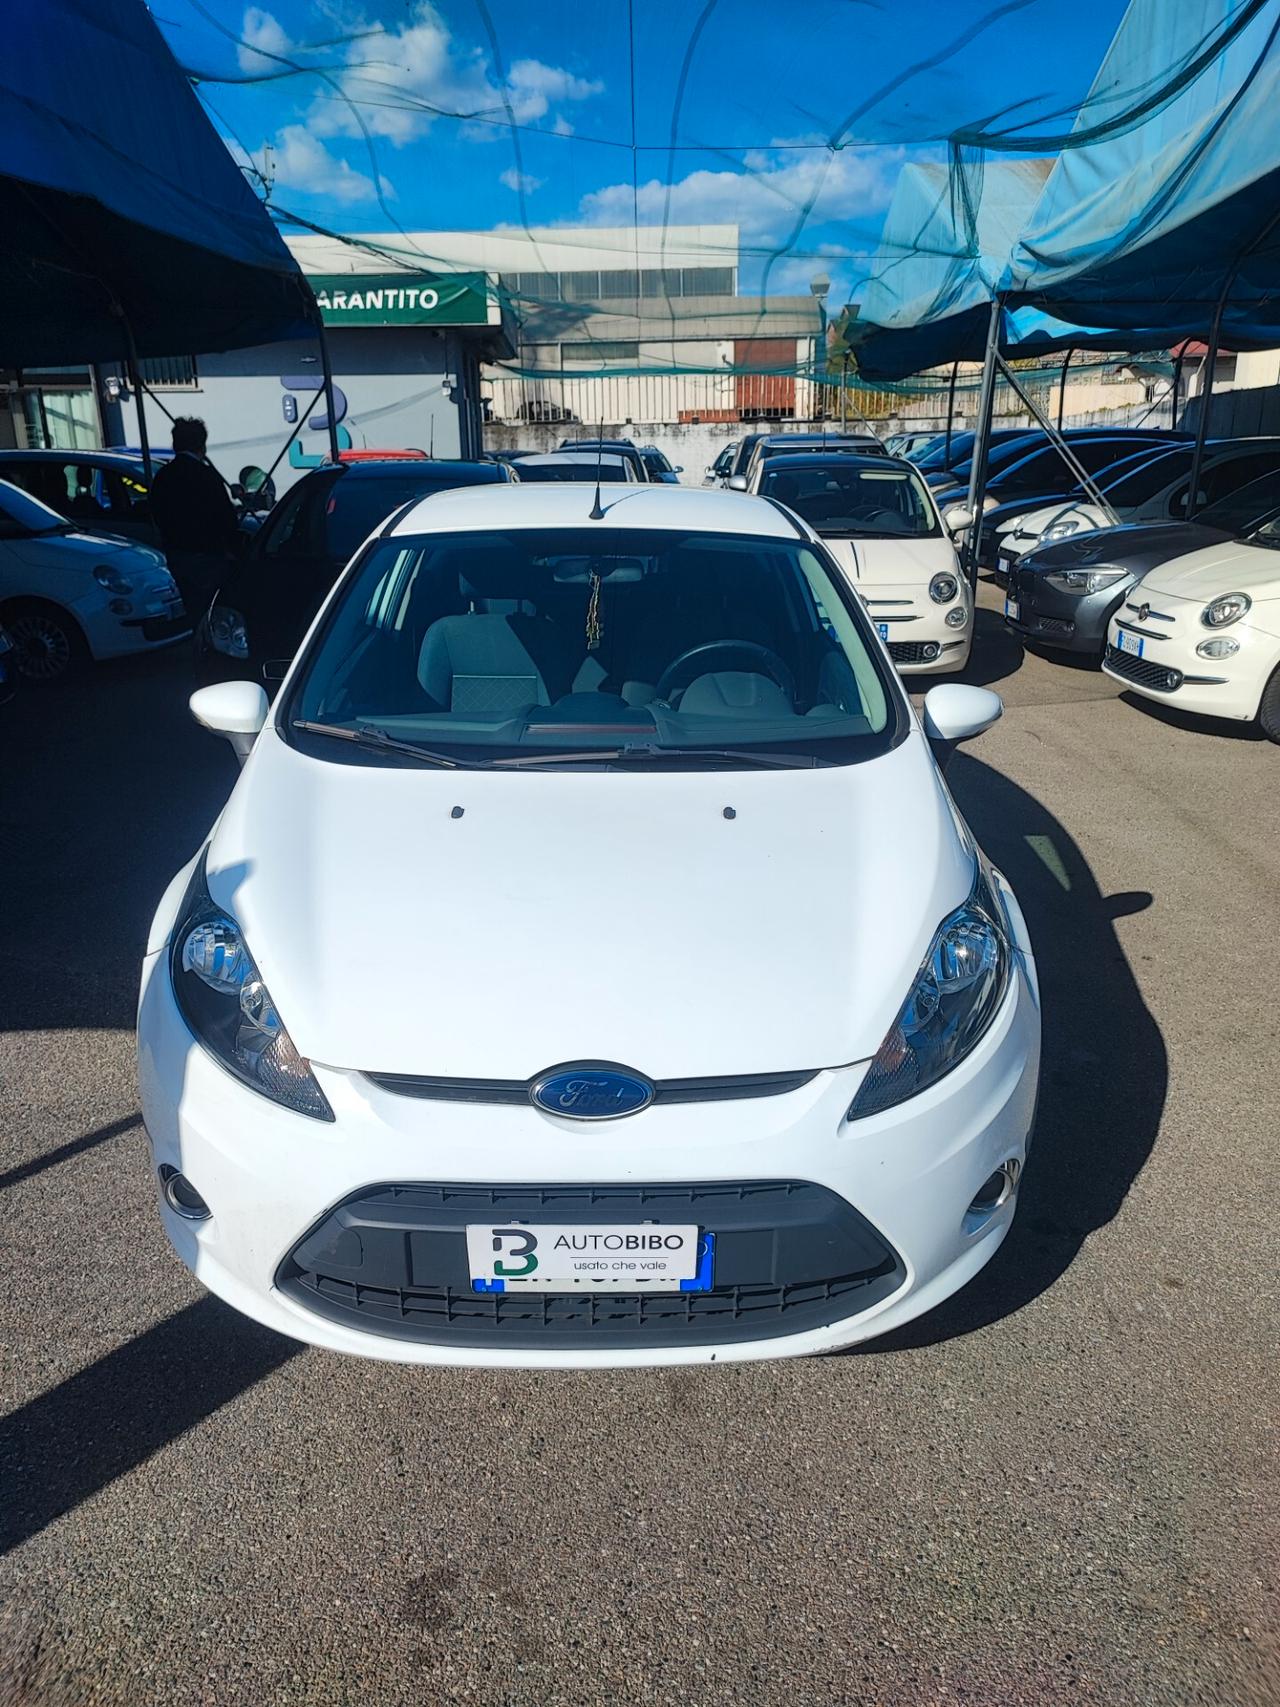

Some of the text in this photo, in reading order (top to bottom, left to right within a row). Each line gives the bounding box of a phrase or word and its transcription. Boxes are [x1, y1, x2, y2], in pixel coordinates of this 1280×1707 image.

[313, 289, 439, 310] ARANTITO
[553, 1234, 684, 1251] AUTOBIBO
[574, 1261, 667, 1271] usato che vale
